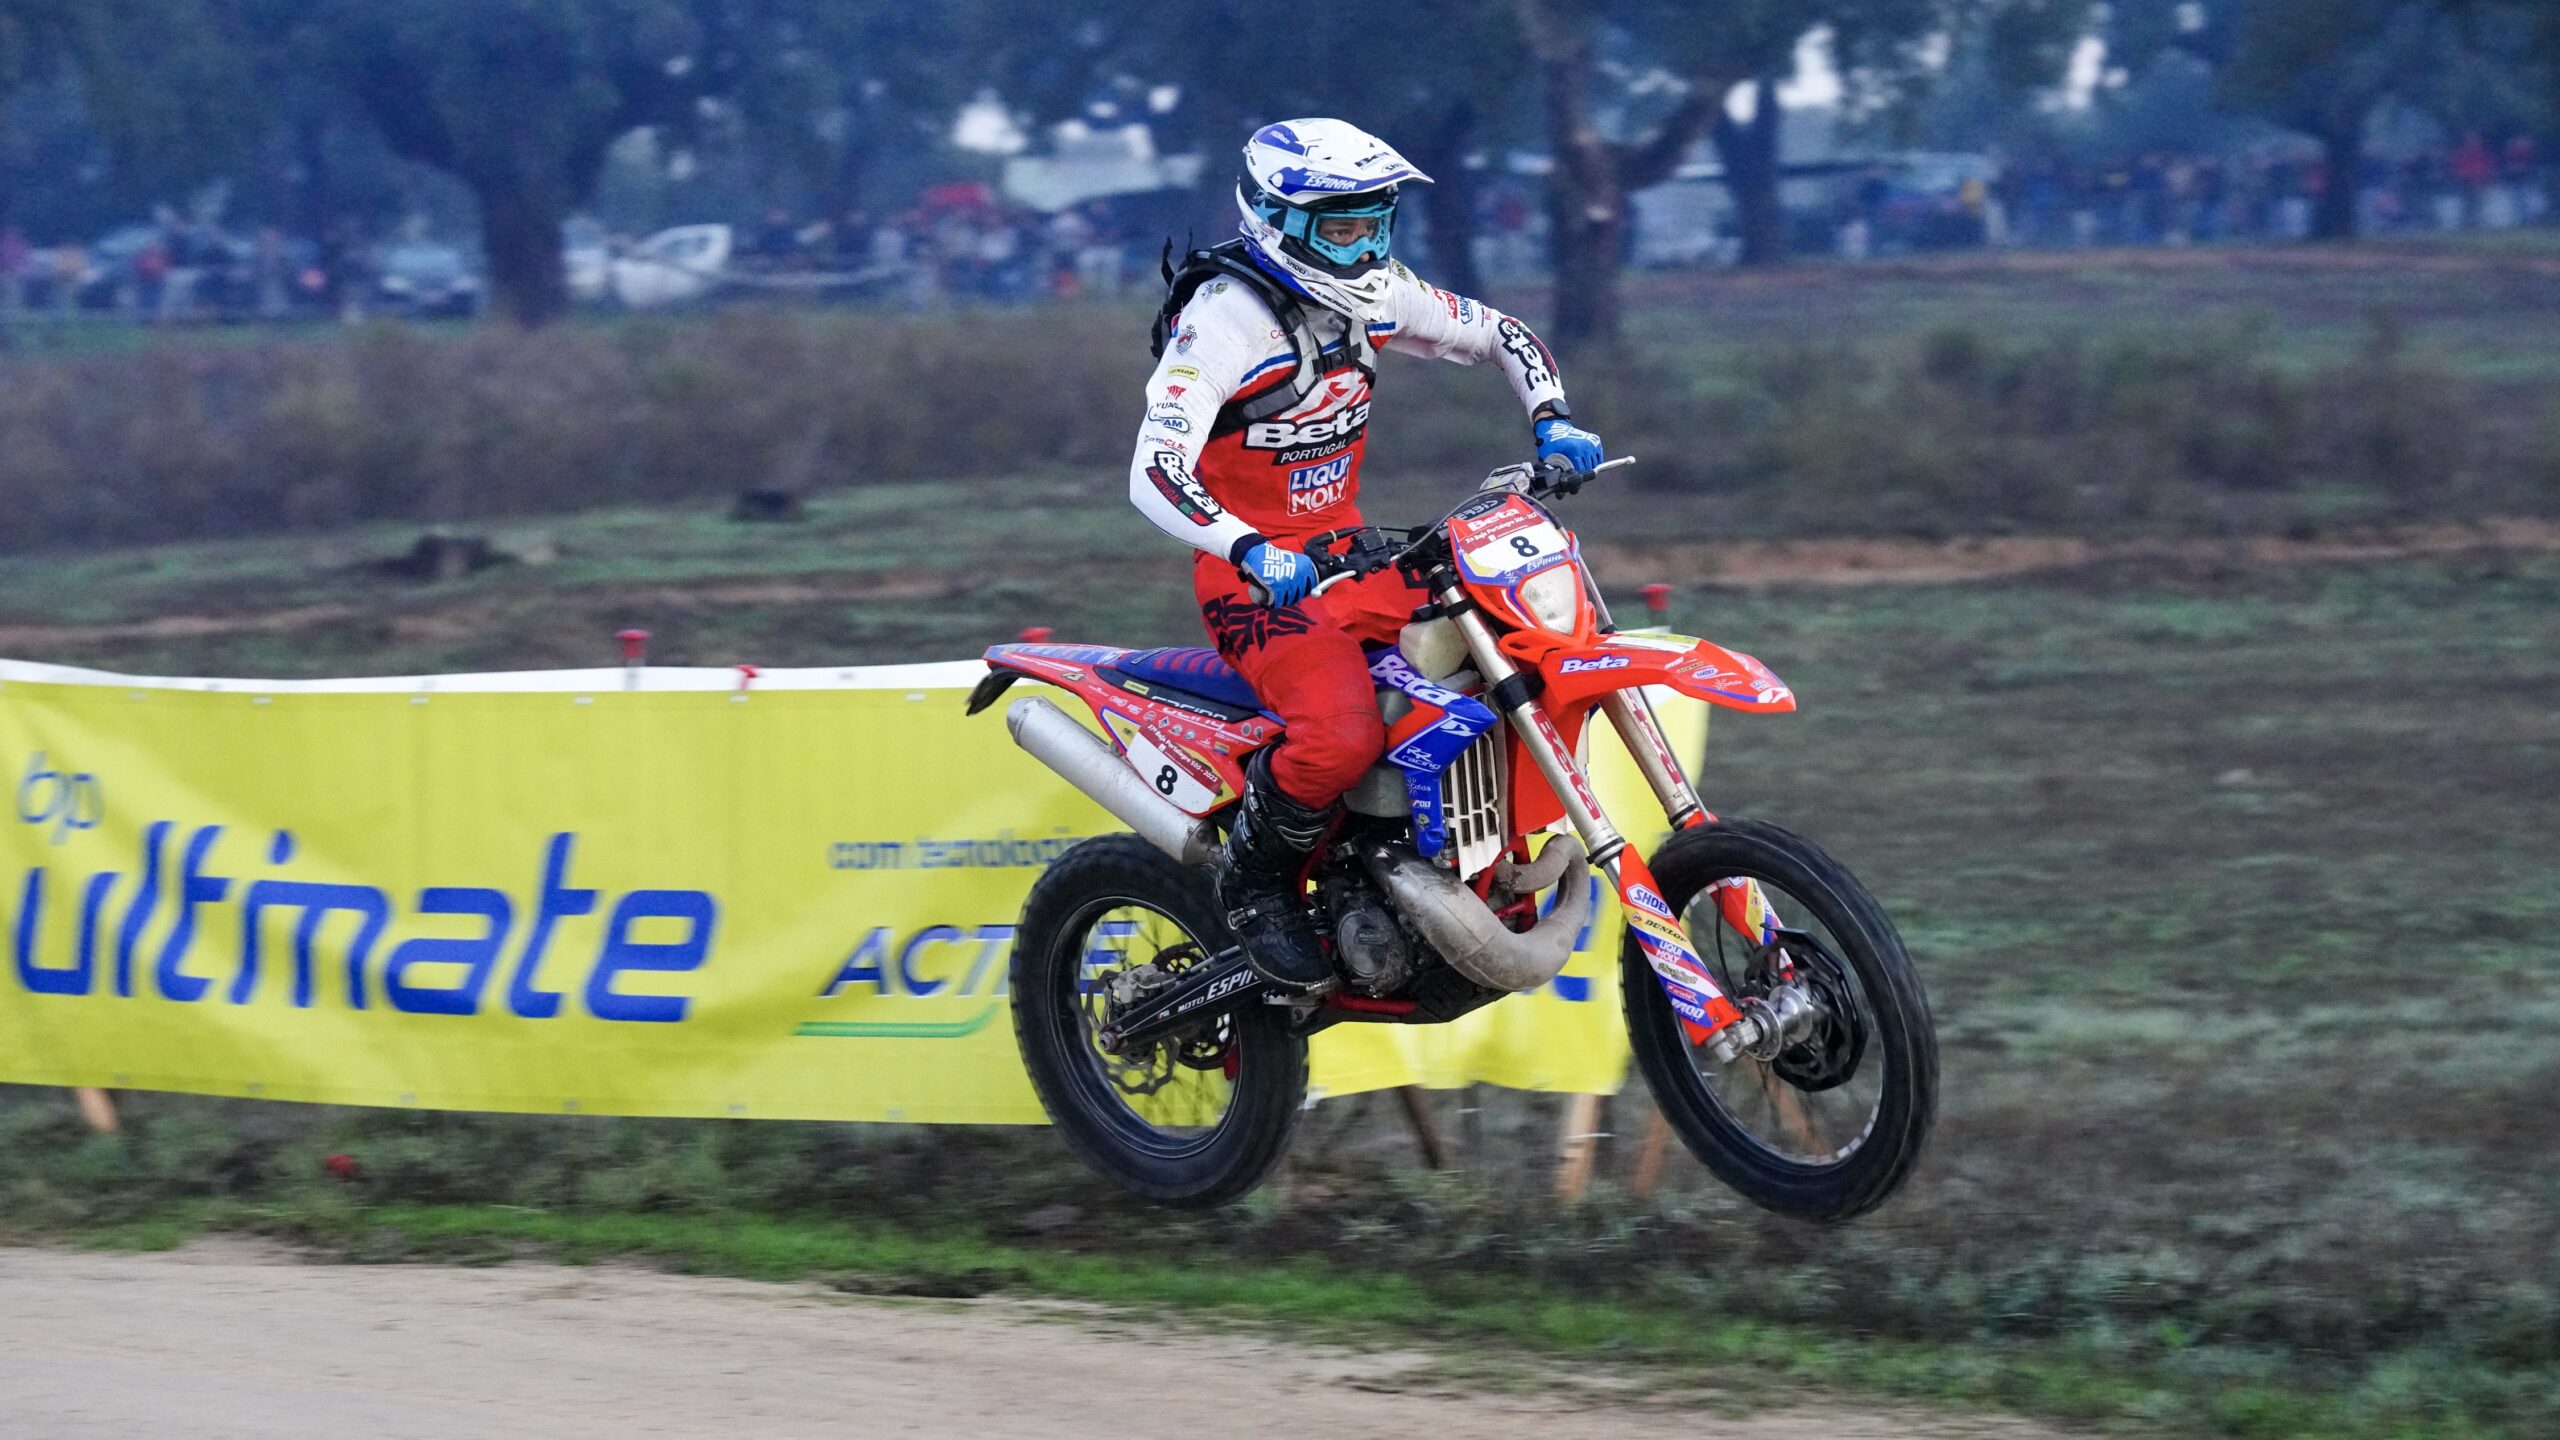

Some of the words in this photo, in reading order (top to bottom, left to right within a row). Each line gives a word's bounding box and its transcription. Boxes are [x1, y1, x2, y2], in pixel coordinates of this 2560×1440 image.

[1246, 401, 1370, 448] Beta
[1281, 439, 1346, 463] PORTUGAL
[1158, 452, 1221, 514] Beta
[1292, 477, 1345, 512] MOLY
[1466, 508, 1520, 532] Beta
[1510, 536, 1539, 557] 8
[1560, 655, 1629, 673] Beta
[1368, 654, 1462, 706] Beta
[1402, 755, 1441, 770] racing
[1156, 765, 1178, 796] 8
[15, 750, 103, 846] bp
[1634, 889, 1668, 914] SHOEI
[12, 820, 722, 1023] ultimate
[1645, 919, 1687, 942] DUNLOP
[1656, 949, 1680, 964] MOLY
[1659, 940, 1682, 956] LIQUI
[1178, 996, 1205, 1013] MOTO
